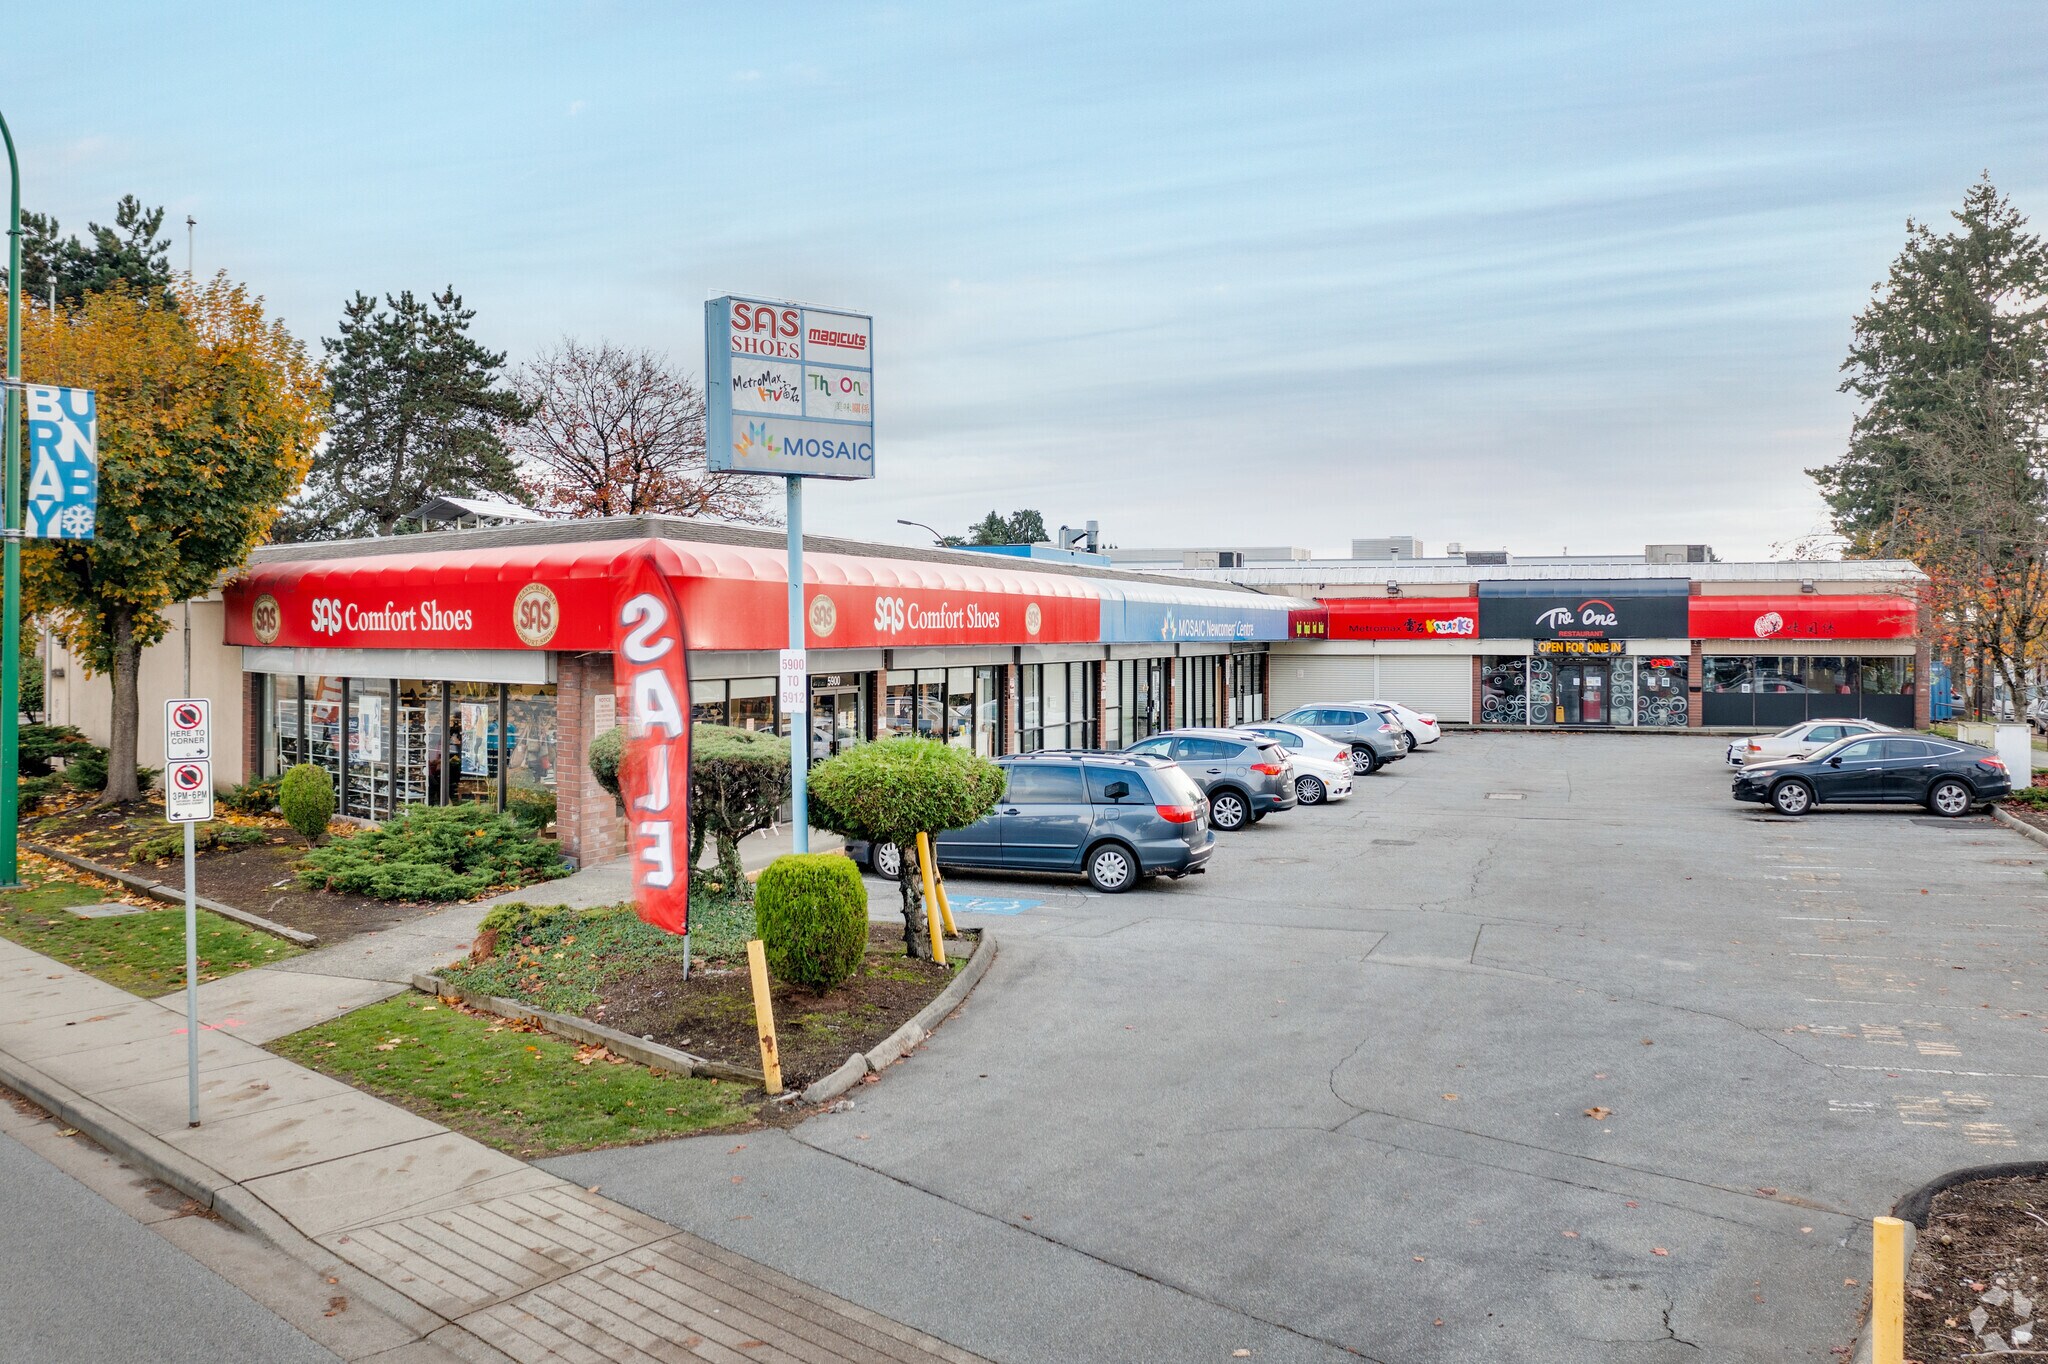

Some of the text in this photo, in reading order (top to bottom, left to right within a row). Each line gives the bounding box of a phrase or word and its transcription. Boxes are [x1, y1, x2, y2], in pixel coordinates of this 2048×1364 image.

[731, 303, 799, 339] SAS
[732, 335, 799, 359] SHOES
[808, 328, 867, 350] magicuts
[758, 385, 783, 402] KTV
[784, 437, 872, 461] MOSAIC
[256, 606, 276, 633] SAS
[311, 598, 342, 636] SAS
[345, 601, 417, 631] Comfort
[421, 599, 473, 631] Shoes
[520, 599, 551, 633] SAS
[813, 604, 832, 628] SAS
[874, 596, 1000, 634] SAS Comfort Shoes
[1582, 609, 1618, 626] One
[1178, 619, 1205, 637] MOSAIC
[1236, 620, 1254, 637] Centre
[1348, 624, 1401, 632] Metromax
[1538, 641, 1621, 653] OPEN FOR DINE IN
[782, 658, 804, 670] 5900
[1650, 658, 1675, 667] OPEN
[787, 675, 799, 687] TO
[827, 675, 840, 686] 5900
[782, 692, 805, 704] 5912
[170, 729, 205, 738] HERE TO
[171, 736, 205, 745] CORNER
